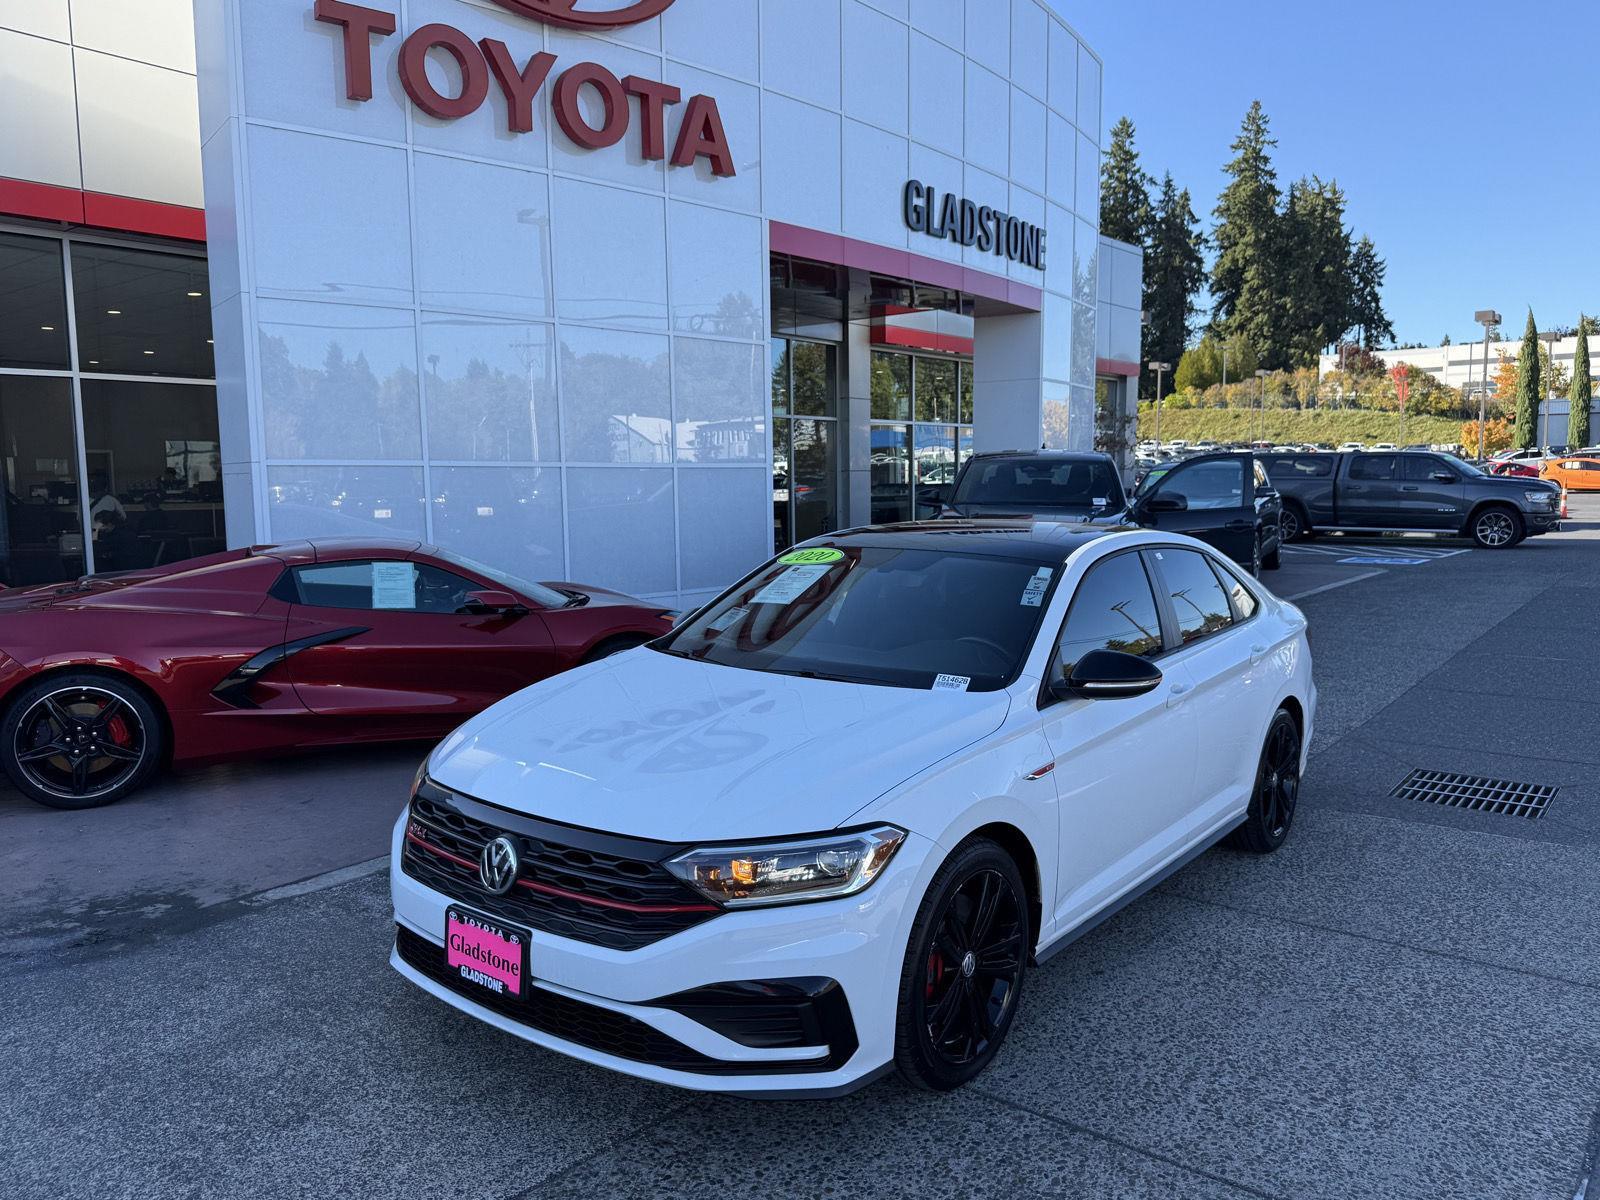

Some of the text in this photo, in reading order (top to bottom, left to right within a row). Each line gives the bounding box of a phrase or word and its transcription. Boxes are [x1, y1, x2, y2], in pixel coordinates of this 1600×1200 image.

[314, 0, 736, 178] TOYOTA
[904, 179, 1047, 271] GLADSTONE
[785, 551, 835, 561] 2020
[463, 916, 504, 938] TOYOTA
[450, 933, 519, 977] Gladstone
[460, 965, 504, 994] GLADSTONE
